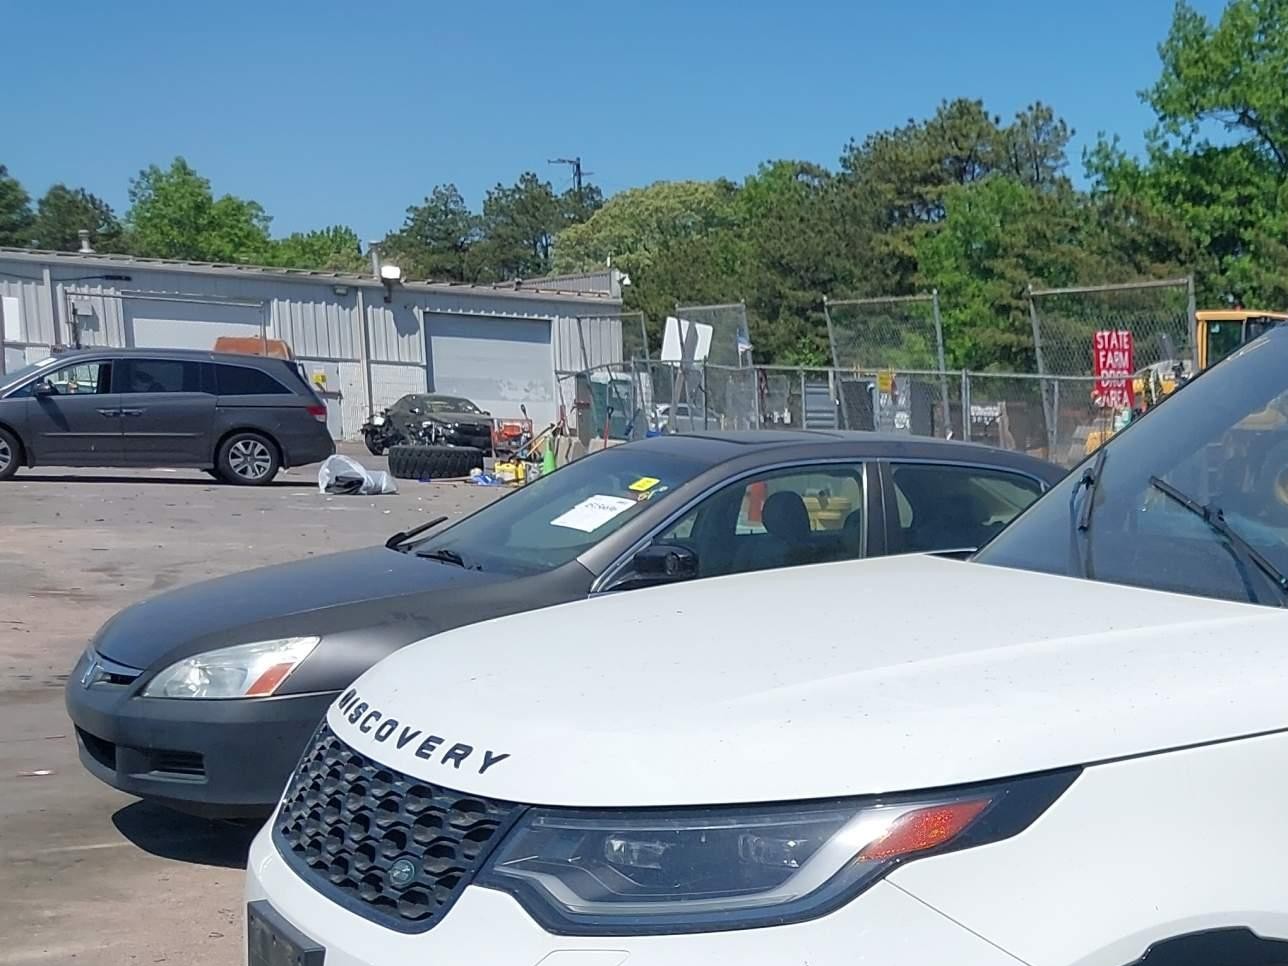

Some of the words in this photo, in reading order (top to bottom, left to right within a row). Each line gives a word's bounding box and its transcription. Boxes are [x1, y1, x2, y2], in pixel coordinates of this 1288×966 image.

[1096, 331, 1130, 349] STATE
[1100, 350, 1129, 369] FARM
[1101, 369, 1129, 388] DROP
[337, 687, 511, 775] DISCOVERY
